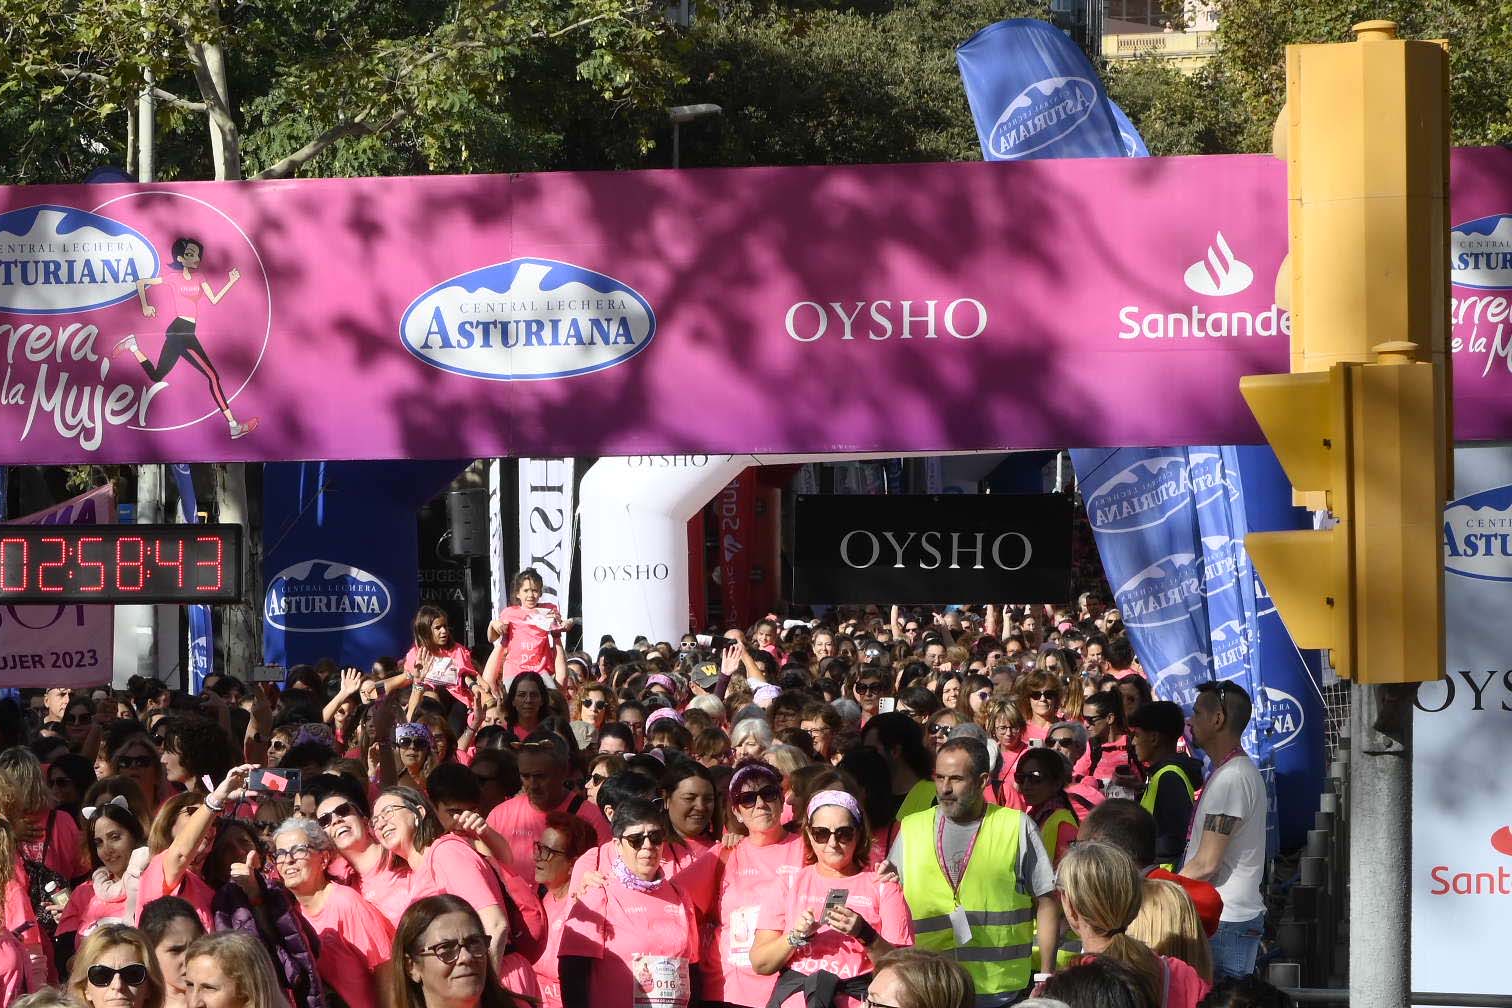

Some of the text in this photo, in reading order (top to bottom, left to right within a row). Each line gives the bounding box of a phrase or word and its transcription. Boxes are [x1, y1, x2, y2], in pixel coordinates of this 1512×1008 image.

[63, 242, 134, 252] LECHERA
[460, 300, 628, 314] CENTRAL LECHERA
[785, 298, 987, 342] OYSHO
[1118, 304, 1292, 340] Santande
[420, 306, 636, 350] ASTURIANA
[0, 366, 25, 406] la
[20, 357, 170, 452] Mujer
[1466, 518, 1512, 528] CENT
[839, 529, 1033, 570] OYSHO
[1443, 521, 1512, 557] ASTU
[0, 536, 222, 591] 02:58:43
[593, 563, 669, 583] OYSHO
[268, 587, 381, 617] ASTURIANA
[51, 648, 98, 670] 2023
[701, 664, 717, 677] W
[656, 980, 676, 989] 016
